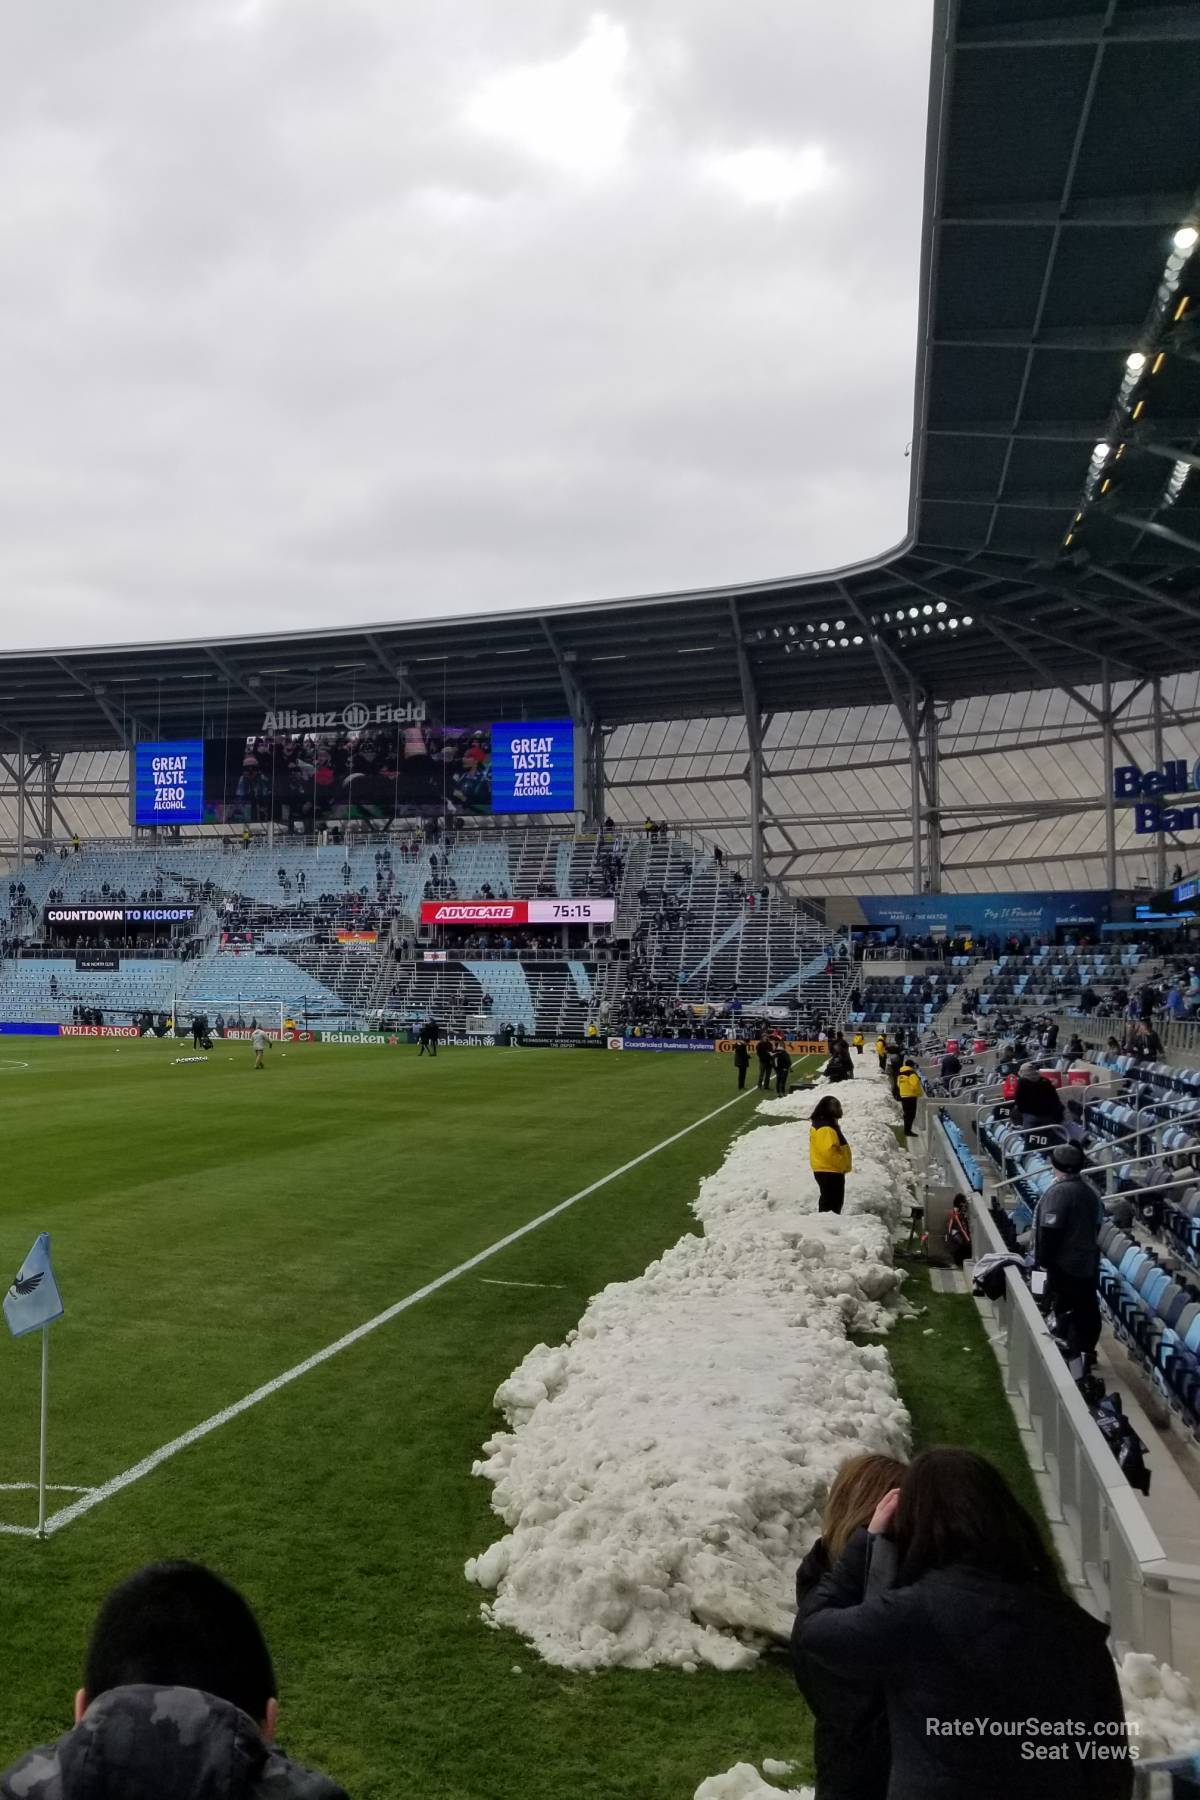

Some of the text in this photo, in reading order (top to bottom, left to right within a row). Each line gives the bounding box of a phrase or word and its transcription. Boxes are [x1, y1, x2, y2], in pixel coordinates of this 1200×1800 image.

[261, 700, 427, 731] Allianz Field
[511, 737, 554, 754] GREAT
[151, 756, 188, 772] GREAT
[511, 753, 554, 770] TASTE.
[152, 771, 188, 786] TASTE.
[514, 771, 551, 788] ZERO
[1114, 759, 1188, 799] Bell
[154, 787, 185, 802] ZERO
[513, 786, 553, 797] ALCOHOL.
[153, 799, 186, 810] ALCOHOL.
[48, 909, 194, 921] COUNTDOWN TO KICKOFF
[435, 906, 515, 919] ADVOCARE
[552, 905, 591, 918] 75:15
[61, 1026, 137, 1037] WELLS FARGO
[321, 1031, 385, 1044] Heineken
[624, 1041, 663, 1049] Coordinated
[689, 1043, 714, 1051] Systems
[799, 1045, 825, 1054] TIRE
[1029, 1134, 1048, 1146] F10
